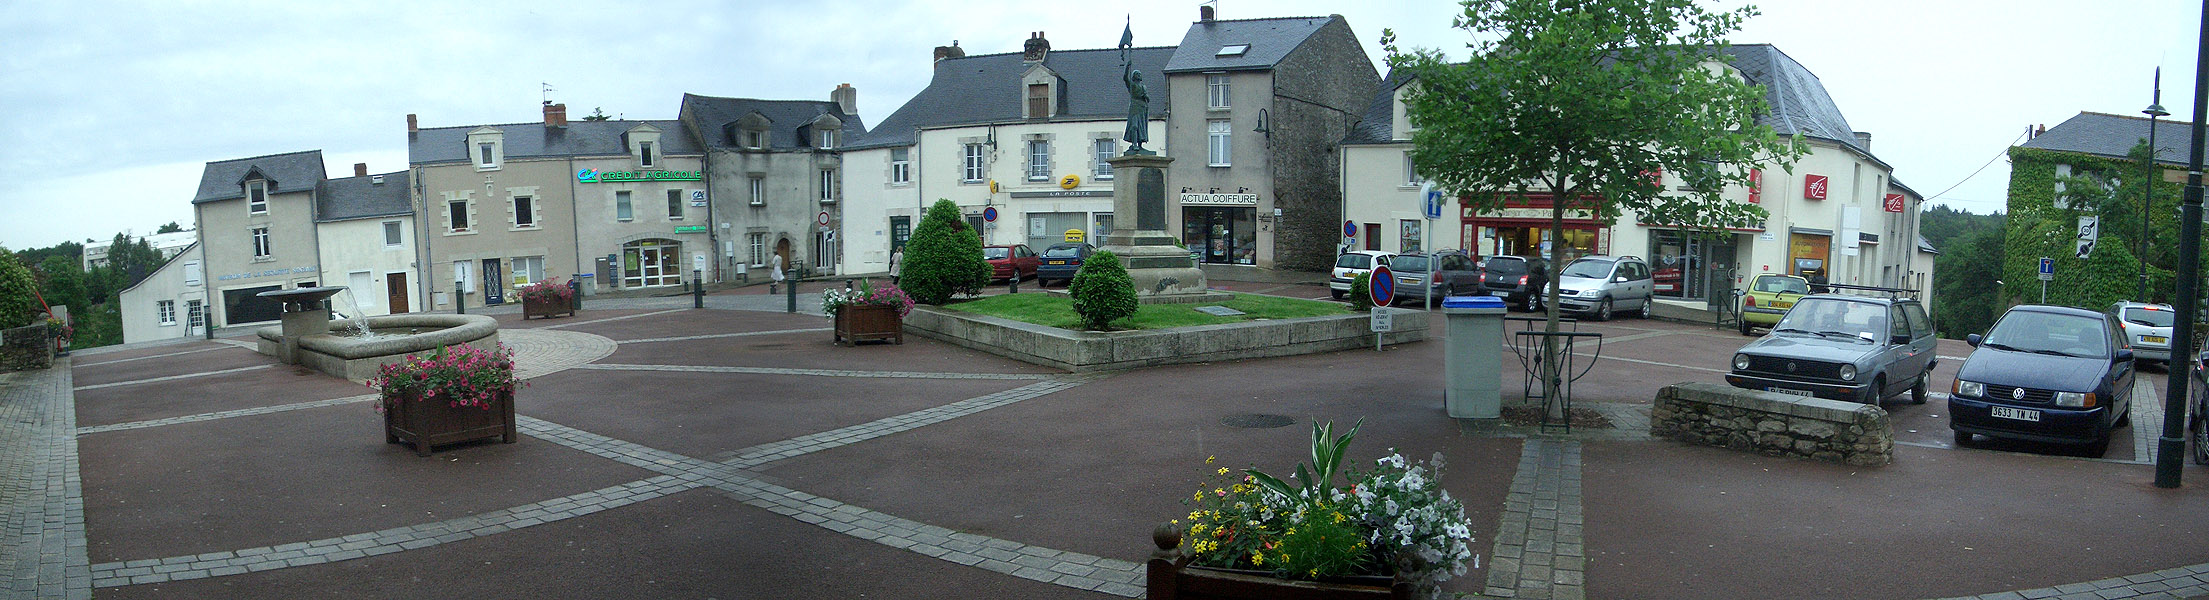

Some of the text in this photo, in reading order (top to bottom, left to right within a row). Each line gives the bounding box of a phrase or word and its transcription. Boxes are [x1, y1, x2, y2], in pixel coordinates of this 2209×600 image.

[646, 170, 702, 179] AGRICOLE
[1181, 194, 1256, 204] ACTUA COIFFURE
[1993, 406, 2038, 421] 3633 YN 44
